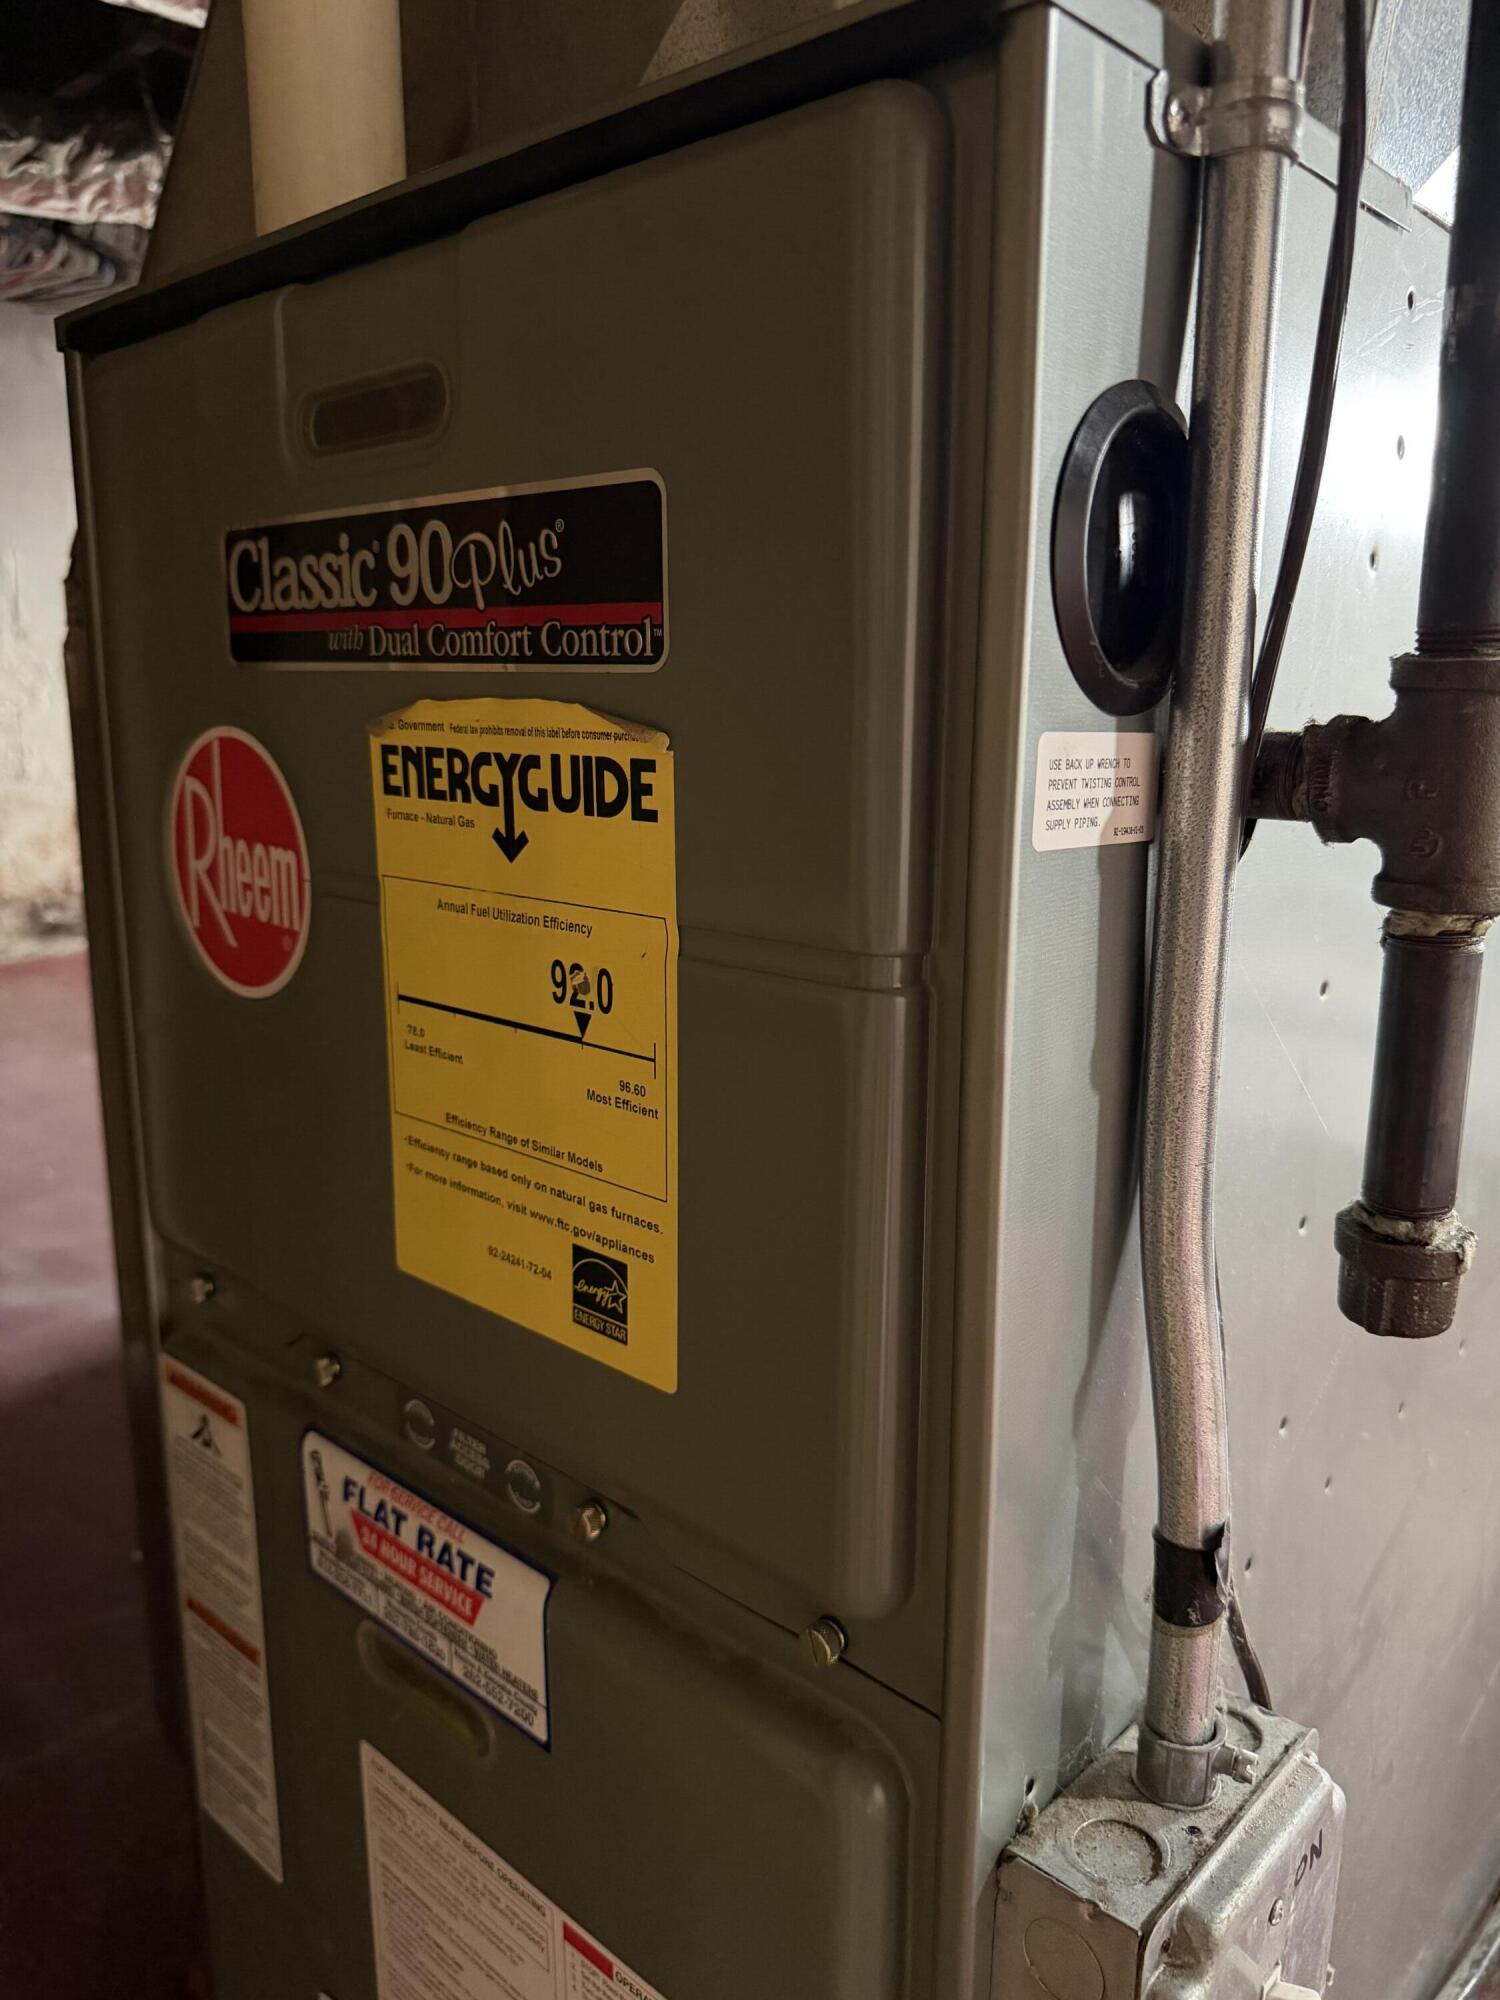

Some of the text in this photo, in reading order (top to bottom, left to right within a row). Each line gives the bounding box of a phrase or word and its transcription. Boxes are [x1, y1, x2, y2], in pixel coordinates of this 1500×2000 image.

[328, 624, 365, 653] with
[369, 624, 420, 657] Dual
[427, 621, 533, 658] Comfort
[398, 718, 446, 733] Government
[449, 723, 468, 735] Federal
[469, 725, 478, 735] law
[480, 725, 503, 737] prohibits
[504, 727, 526, 737] removal
[527, 727, 533, 737] of
[534, 727, 545, 737] this
[546, 728, 561, 739] label
[561, 728, 580, 739] before
[581, 730, 612, 740] consumer
[1049, 757, 1131, 770] USE BACK UP WRENCH TO
[380, 744, 659, 823] ENERGYGUIDE
[1048, 776, 1141, 791] PREVENT TWISTING CONTROL
[387, 808, 419, 822] Furnace
[426, 812, 456, 827] Natural
[458, 815, 475, 829] Gas
[1046, 795, 1140, 811] ASSEMBLY WHEN CONNECTING
[1045, 816, 1101, 831] SUPPLY PIPING.
[184, 737, 301, 949] Rheem
[437, 899, 593, 939] Annual Fuel Utilization Efficiency
[551, 959, 613, 1015] 92.0
[404, 1040, 463, 1064] Least Efficient
[586, 1088, 659, 1120] Most Efficient
[619, 1079, 646, 1097] 96.60
[445, 1112, 604, 1173] Efficiency Range of Similar Models
[452, 1151, 478, 1169] range
[480, 1160, 508, 1180] based
[511, 1171, 531, 1190] only
[534, 1180, 547, 1192] on
[550, 1184, 586, 1207] natural
[588, 1199, 608, 1216] gas
[611, 1206, 664, 1235] furnaces.
[425, 1170, 447, 1186] more
[449, 1176, 504, 1208] information,
[507, 1199, 528, 1216] visit
[529, 1209, 656, 1264] www.ftc.gov/appliances
[574, 1308, 627, 1342] ENERGY STAR
[342, 1475, 408, 1538] FLAT
[416, 1527, 495, 1599] RATE
[382, 1537, 417, 1577] HOUR
[418, 1559, 474, 1619] SERVICE
[1294, 1828, 1322, 1888] ON
